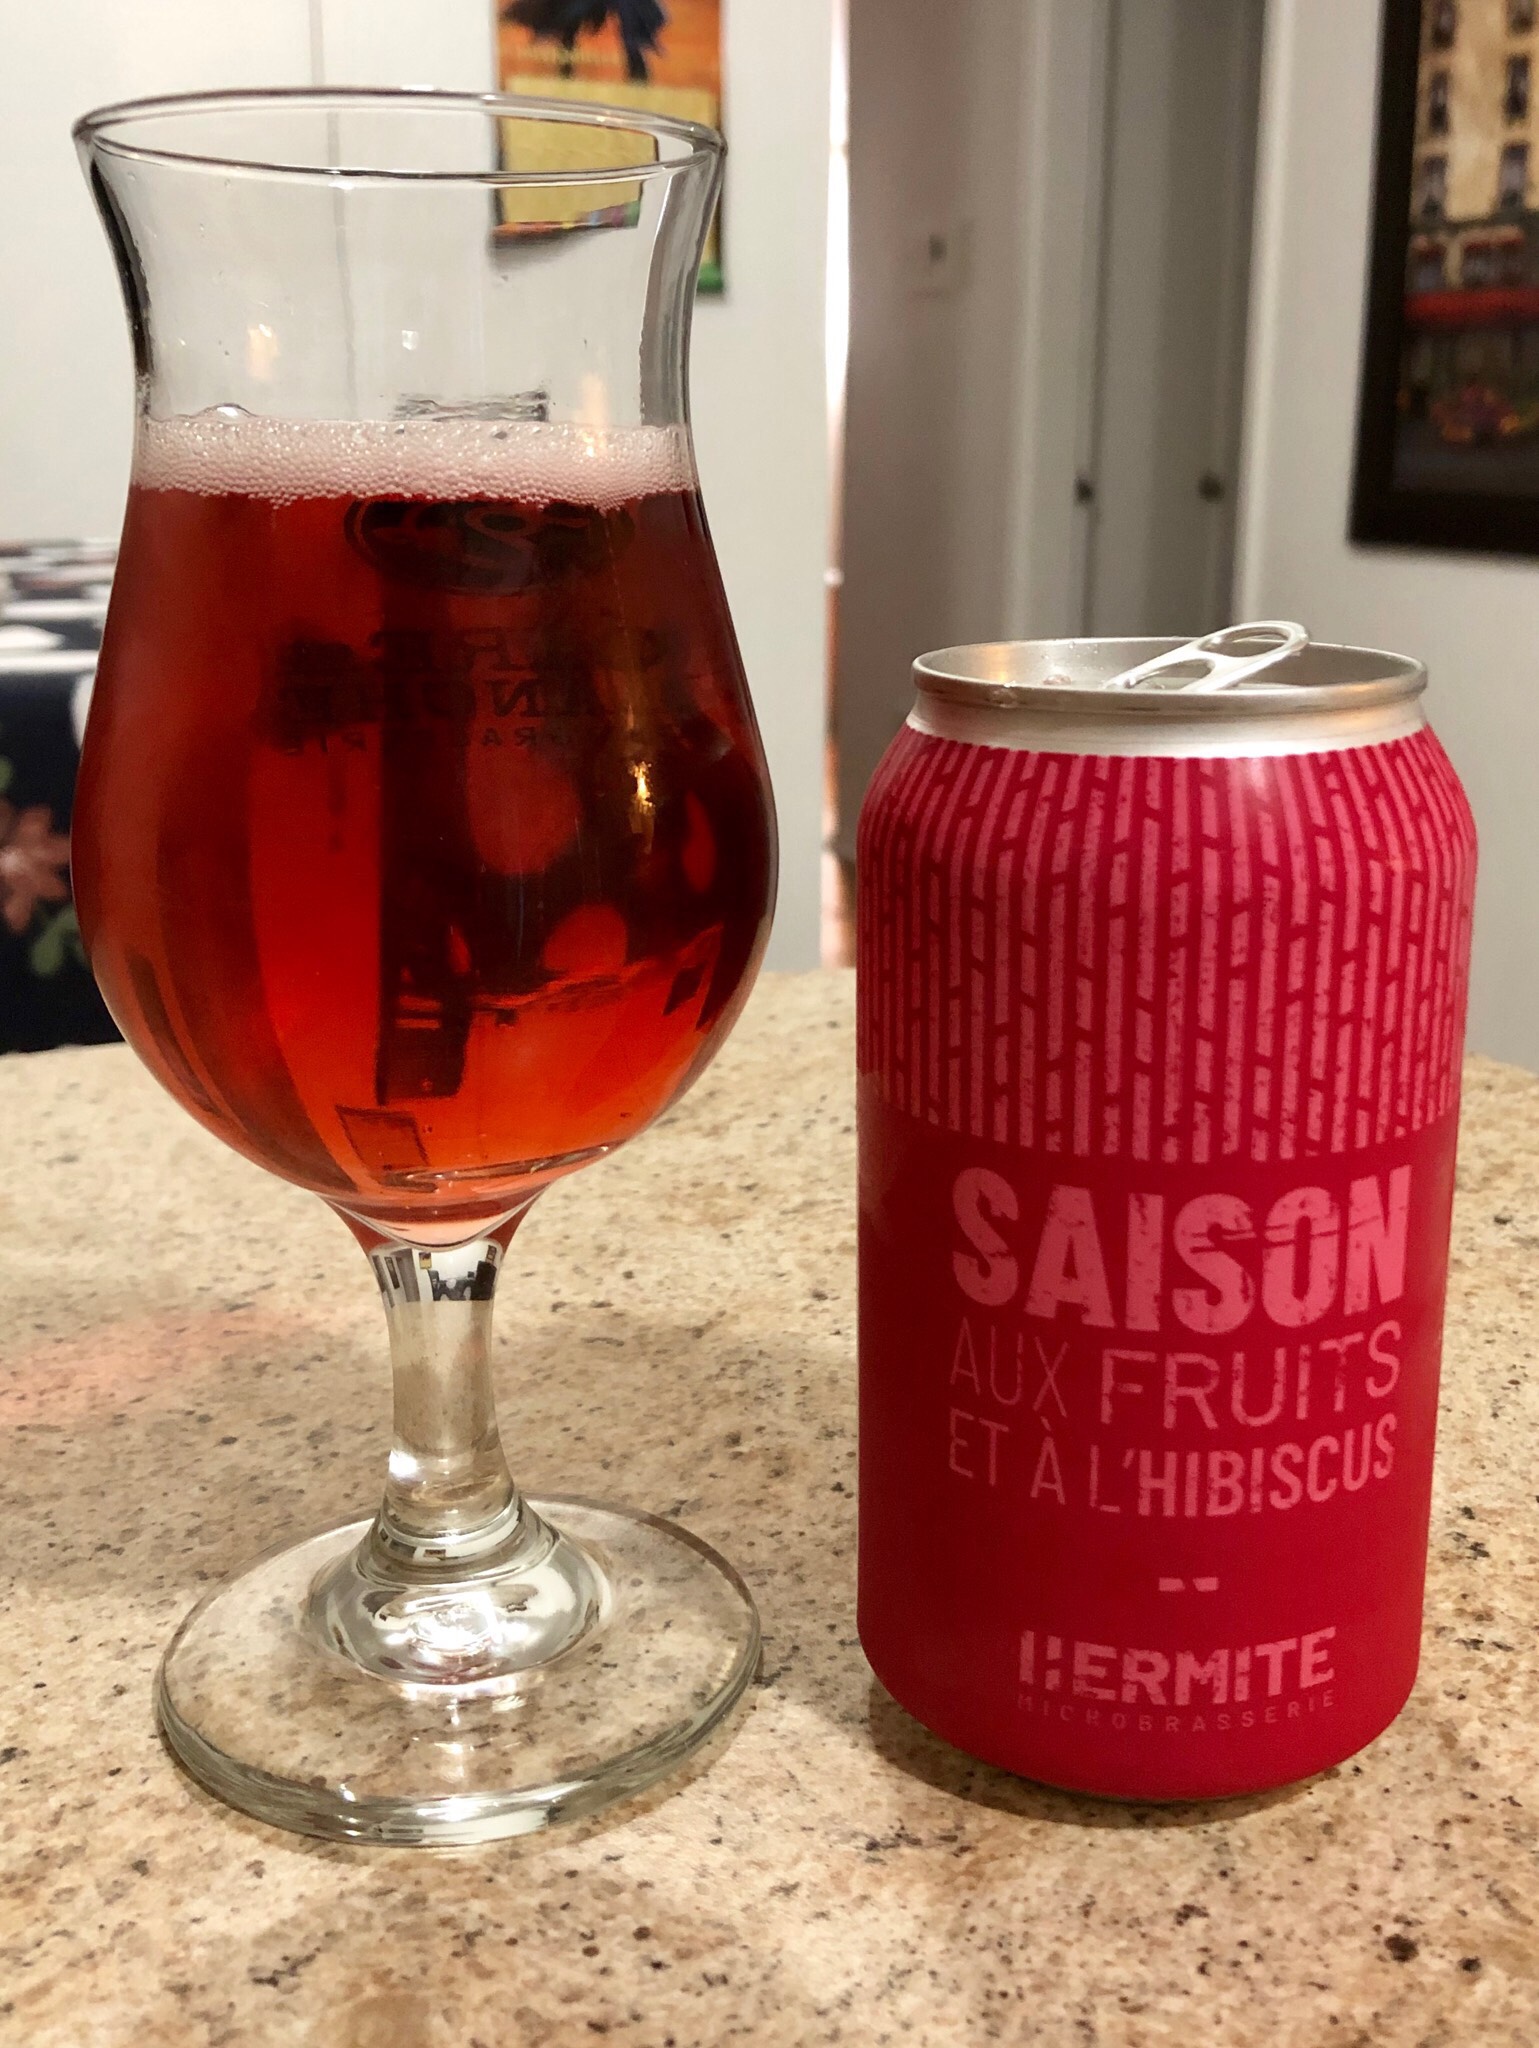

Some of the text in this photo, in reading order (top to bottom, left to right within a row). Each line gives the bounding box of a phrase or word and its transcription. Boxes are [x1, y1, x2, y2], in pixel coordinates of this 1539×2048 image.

[952, 1165, 1411, 1333] SAISON
[949, 1316, 1400, 1429] AUX FRUITS
[948, 1407, 1397, 1516] ET À L'HIBISCUS
[1017, 1689, 1335, 1733] MICROBRASSERIE
